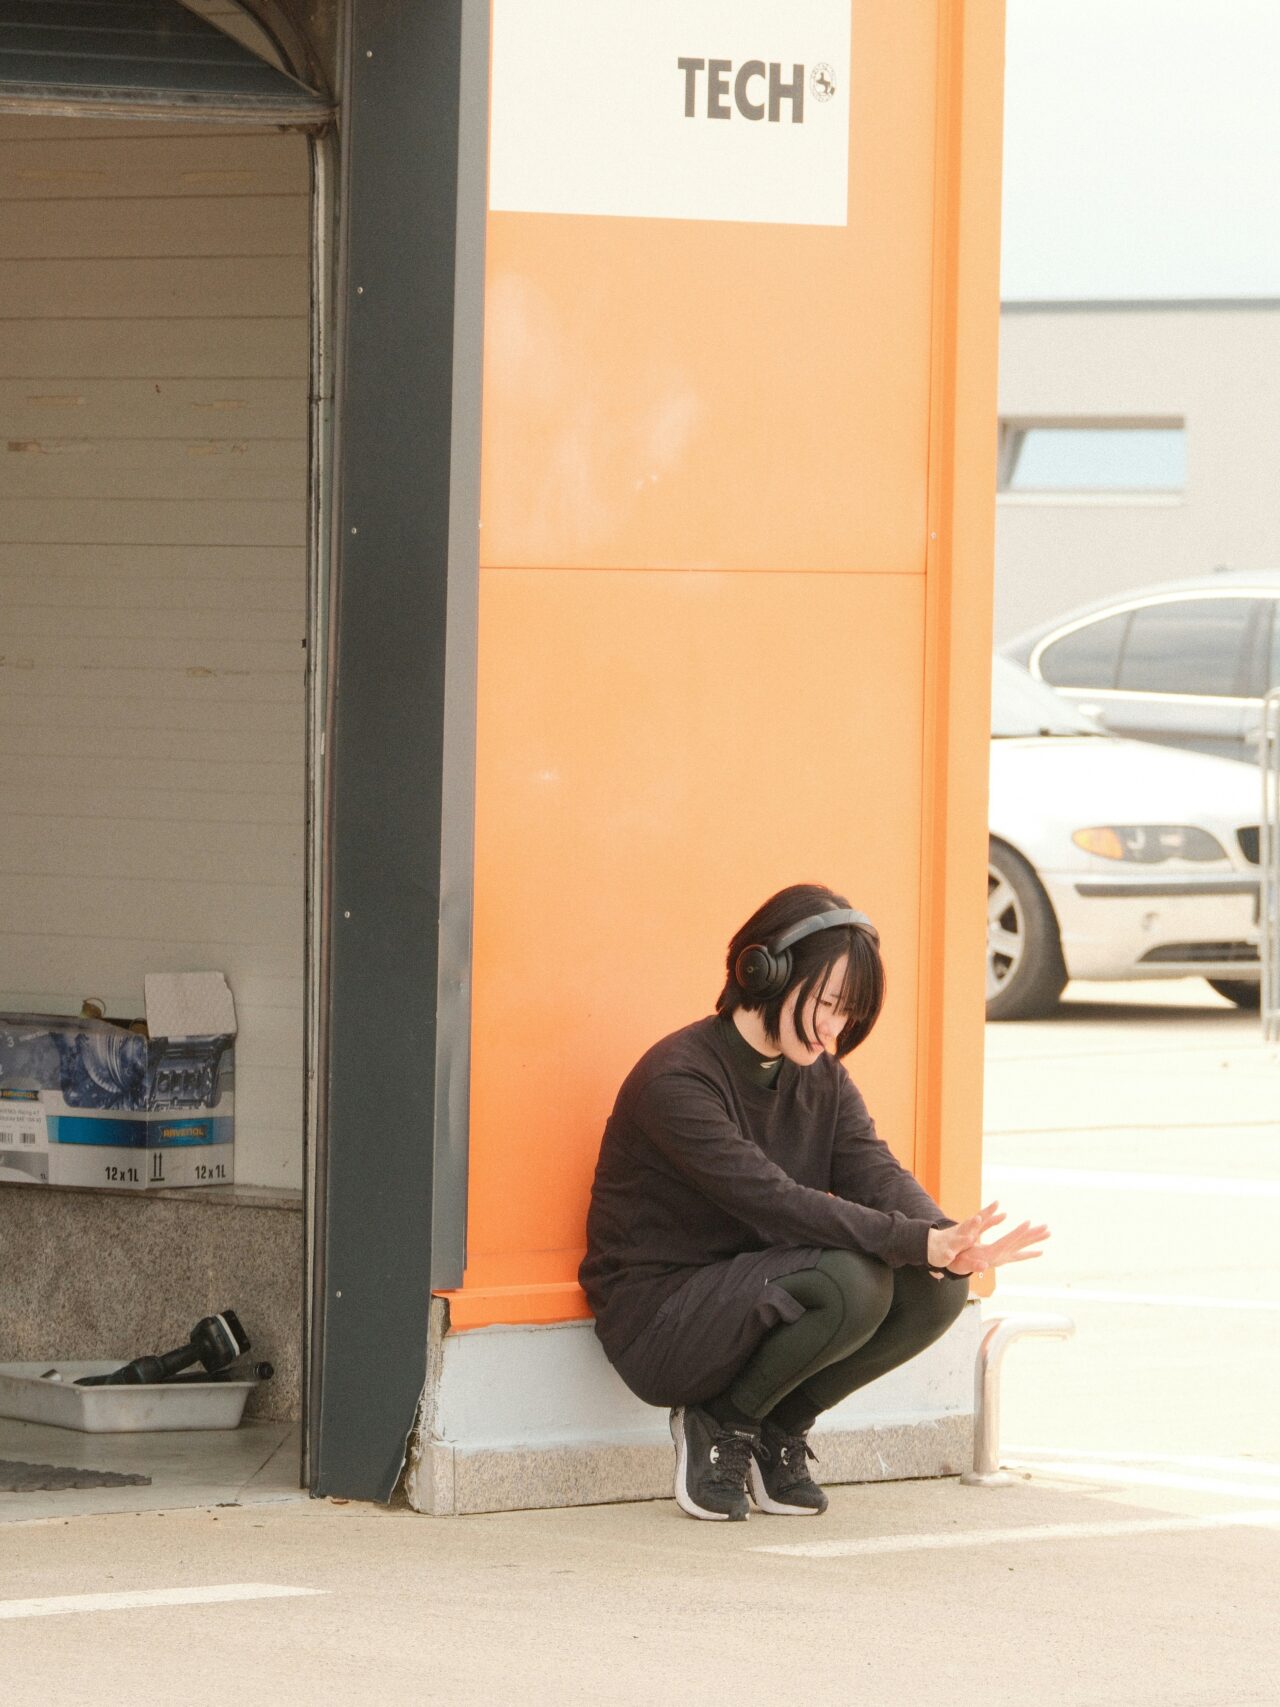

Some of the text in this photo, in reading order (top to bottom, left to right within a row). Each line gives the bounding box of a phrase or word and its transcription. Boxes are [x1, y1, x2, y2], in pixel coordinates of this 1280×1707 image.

[677, 56, 805, 124] TECH
[105, 1166, 139, 1182] 12 x 1L
[195, 1164, 226, 1179] 12 x 1L
